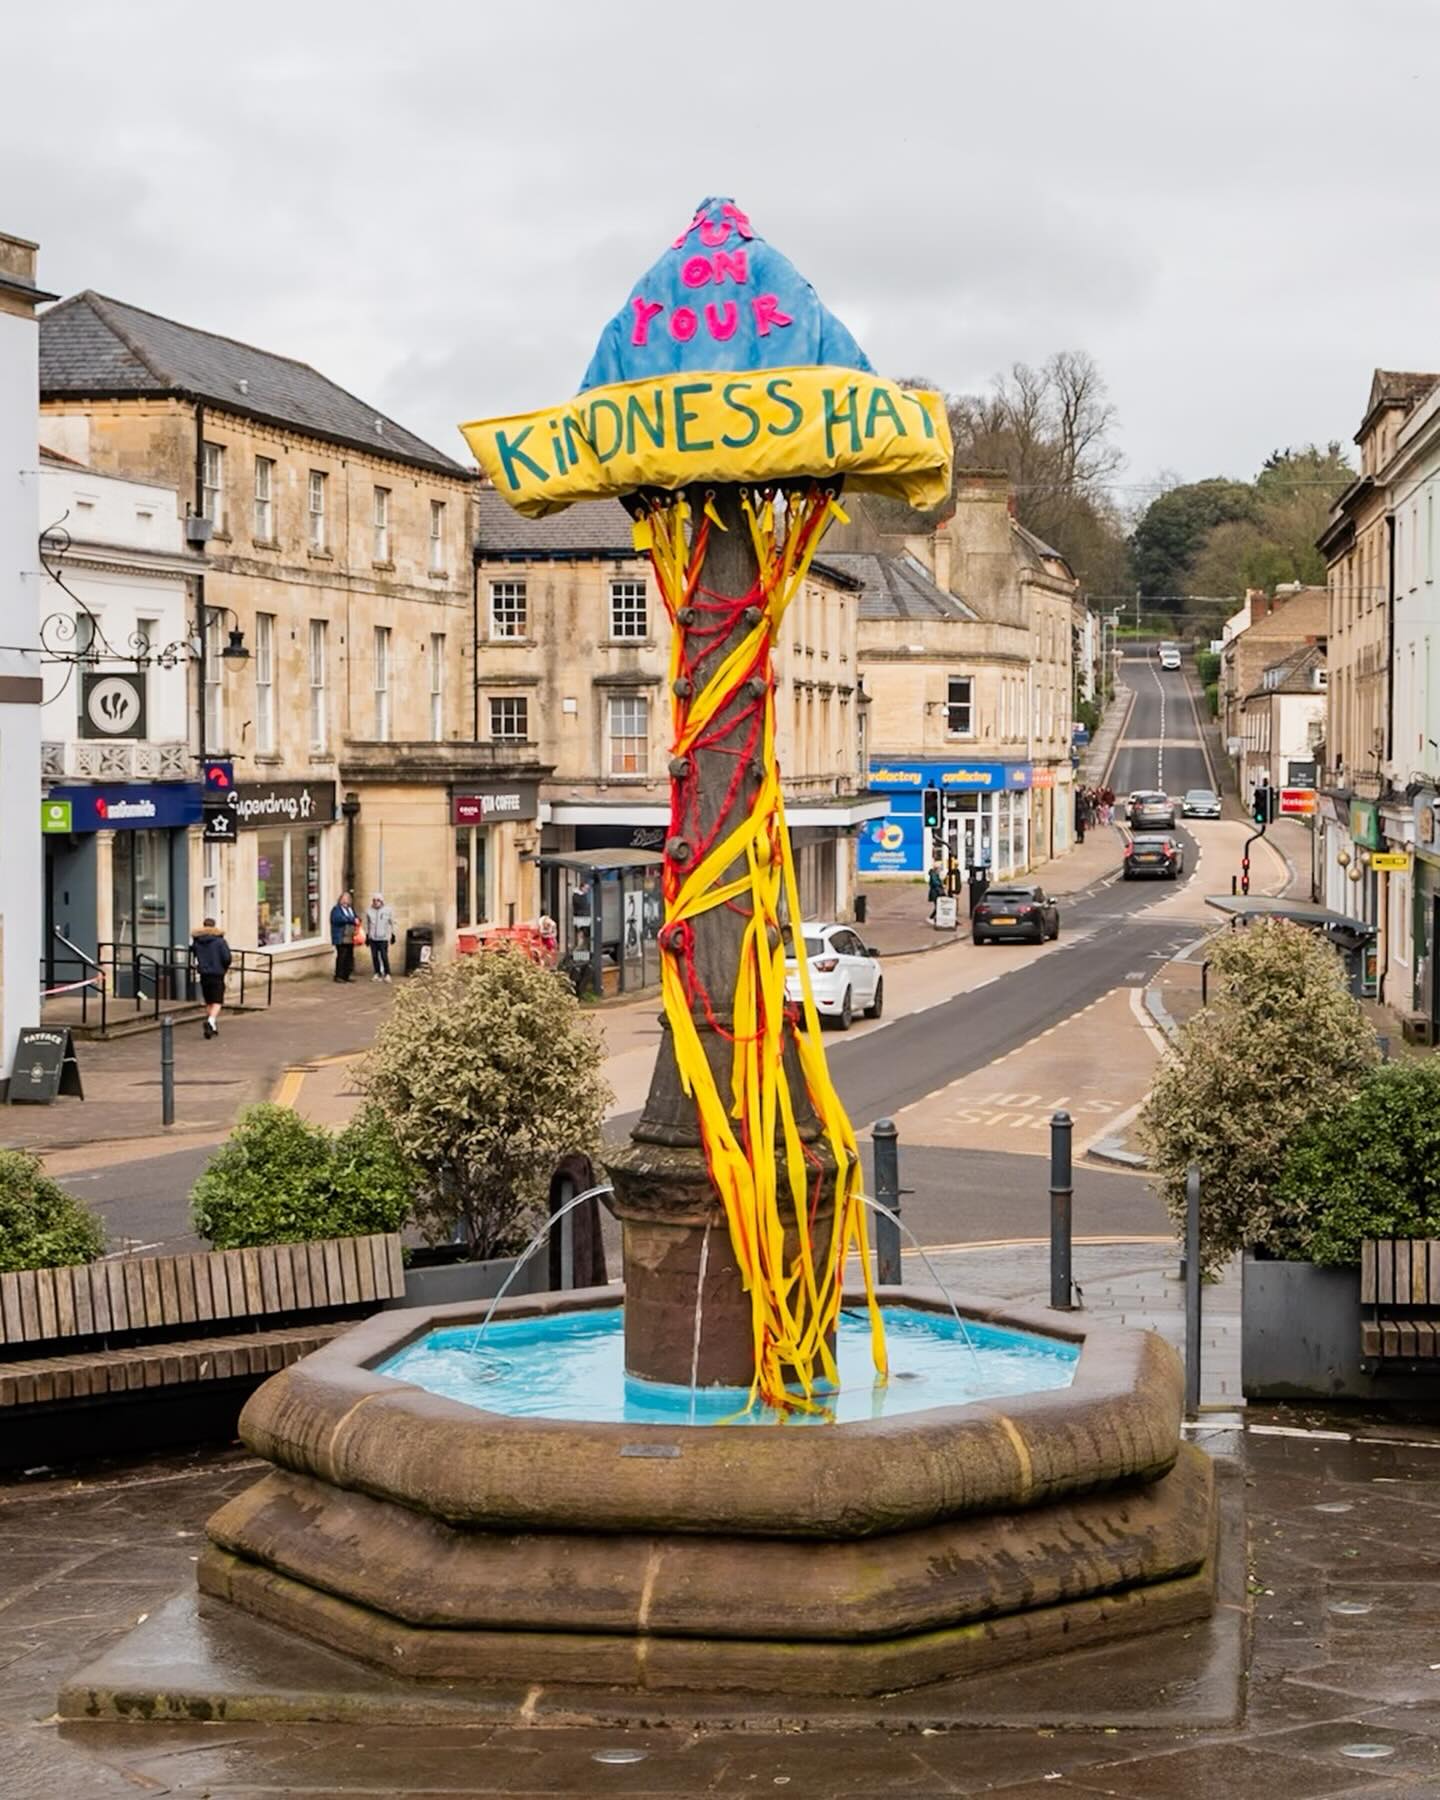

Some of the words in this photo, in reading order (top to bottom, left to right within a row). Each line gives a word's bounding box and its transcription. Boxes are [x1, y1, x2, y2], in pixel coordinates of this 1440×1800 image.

[680, 250, 747, 288] ON
[631, 293, 793, 346] YOUR
[227, 791, 298, 821] Superdrug
[495, 794, 521, 811] COFFEE
